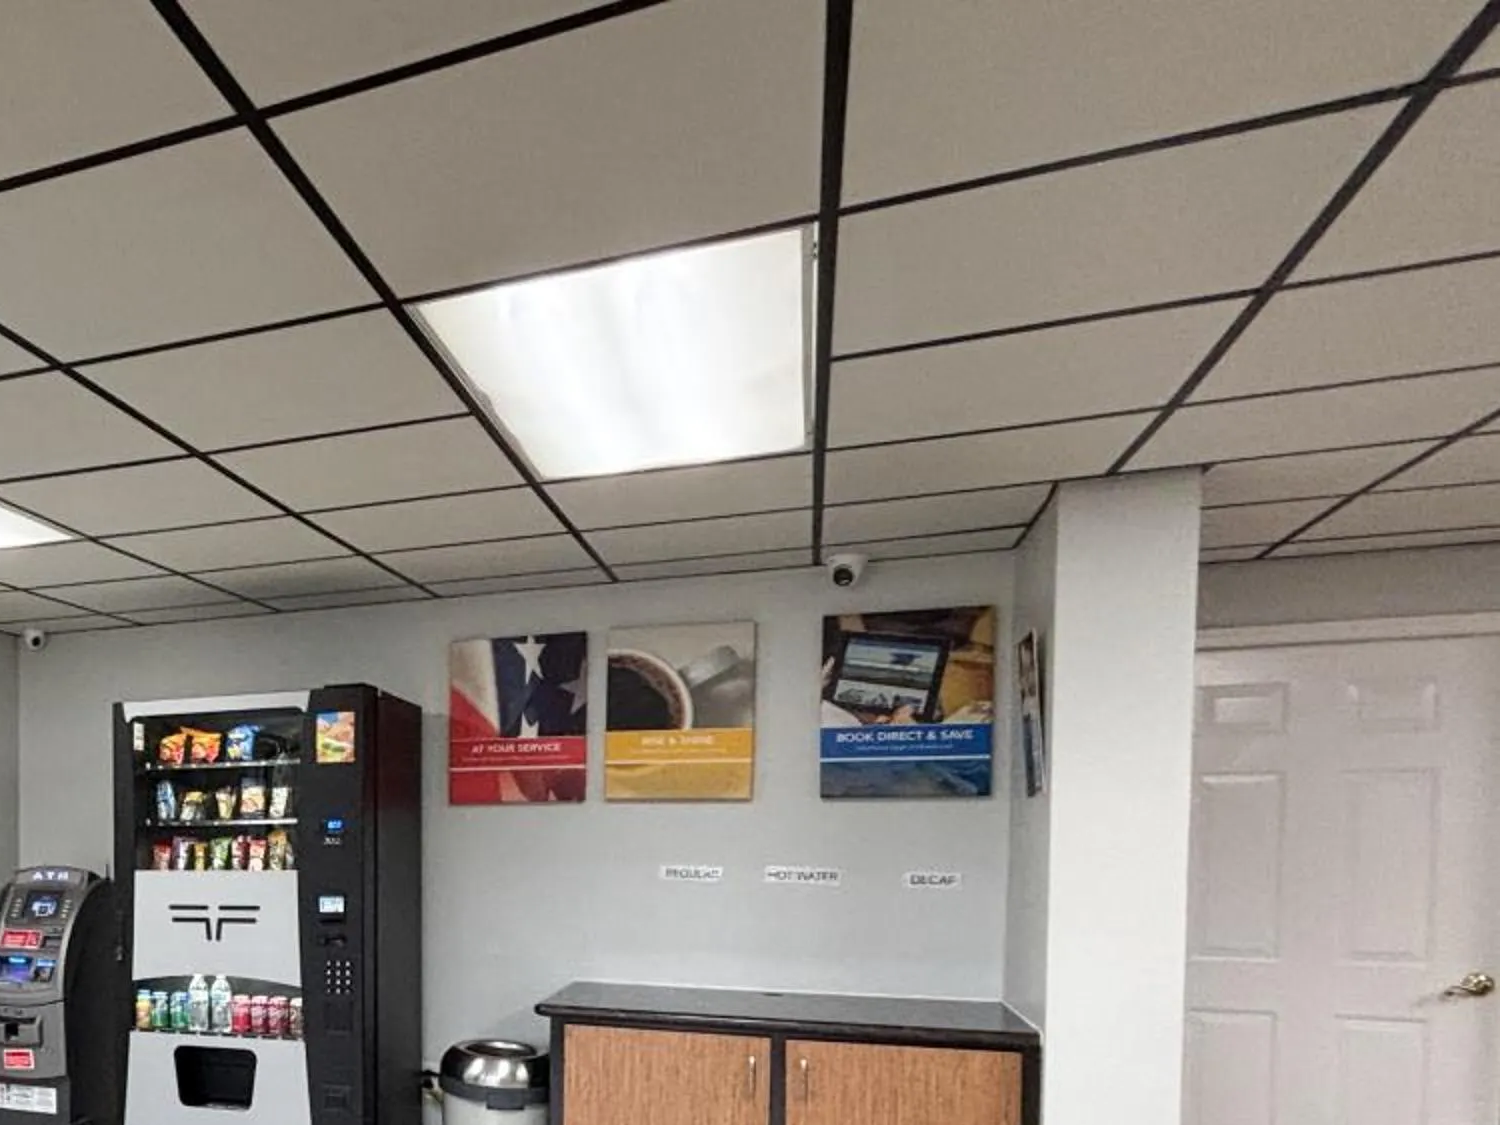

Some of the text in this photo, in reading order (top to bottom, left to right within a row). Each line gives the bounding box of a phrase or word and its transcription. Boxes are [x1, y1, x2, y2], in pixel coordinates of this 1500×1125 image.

[835, 729, 975, 743] BOOK DIRECT & SAVE
[487, 742, 515, 753] YOUR
[517, 741, 562, 752] SERVICE
[32, 871, 69, 881] ATM
